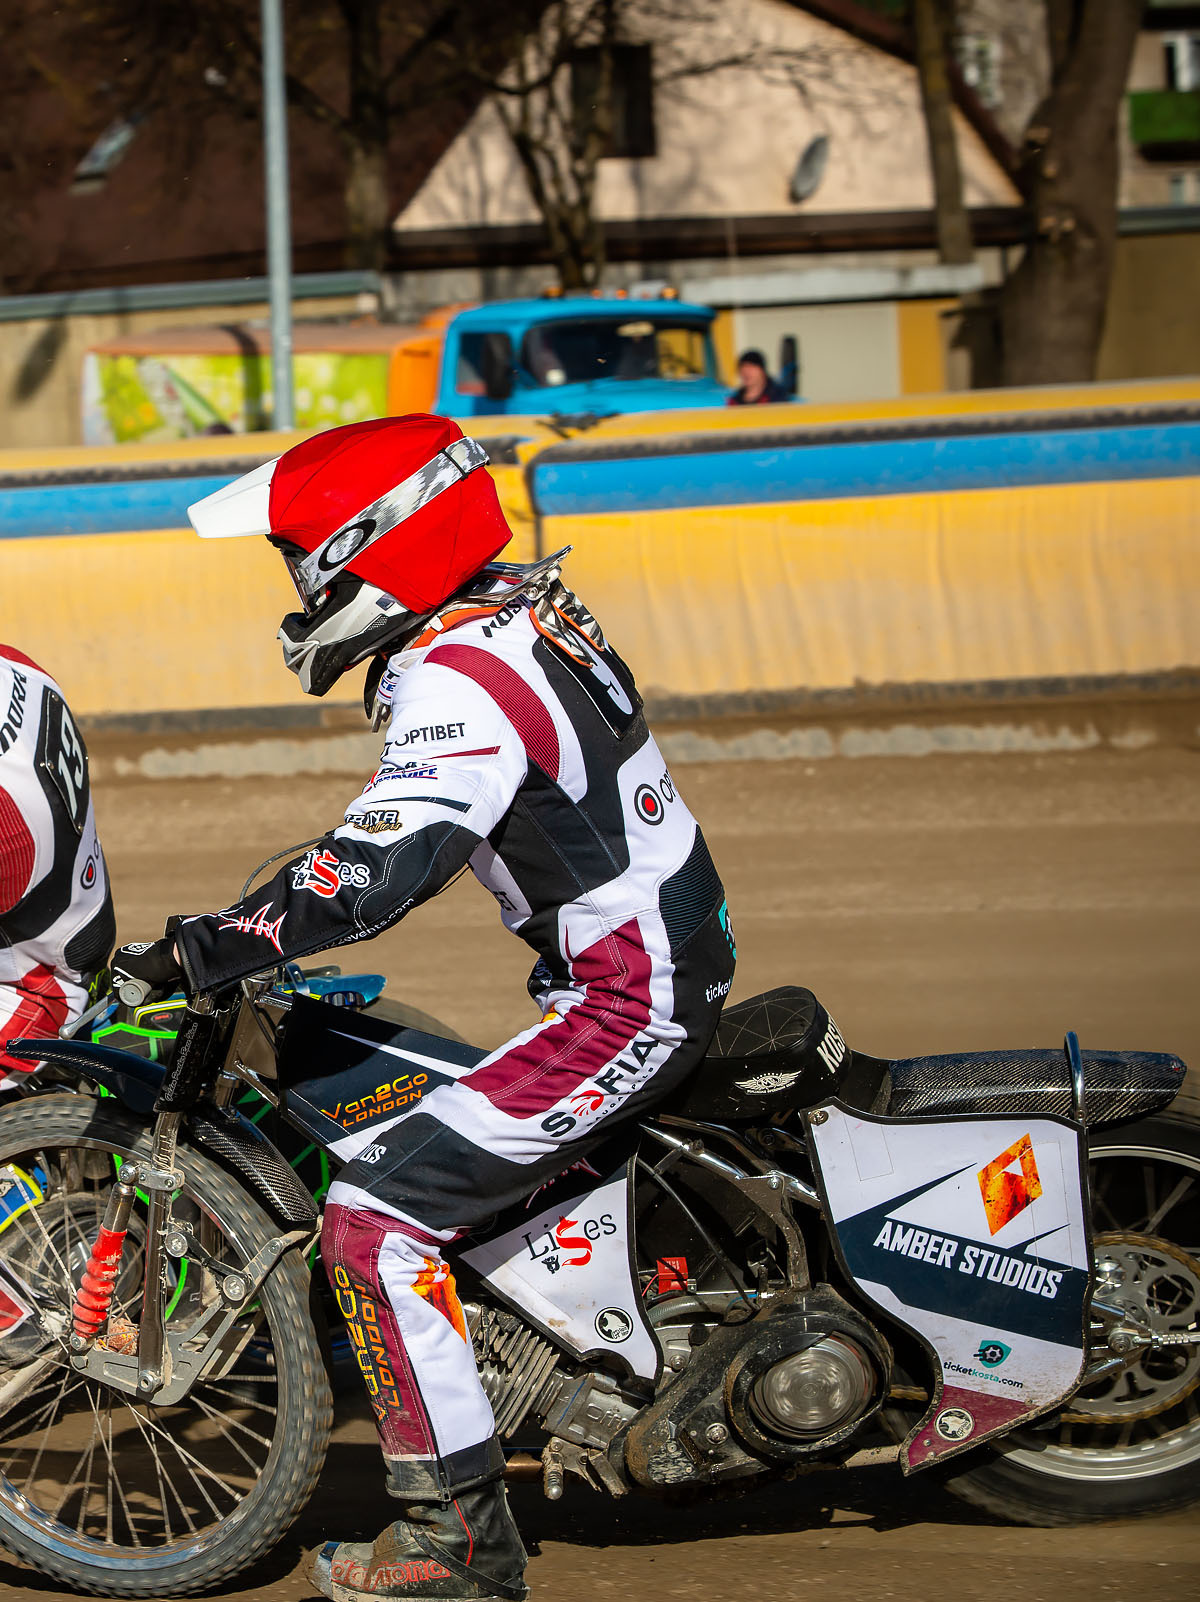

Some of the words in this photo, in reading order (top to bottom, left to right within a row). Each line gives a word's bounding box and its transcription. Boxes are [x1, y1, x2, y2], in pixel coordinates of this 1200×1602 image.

[58, 703, 84, 820] 13
[321, 1072, 428, 1119] Van2Go
[343, 1089, 423, 1127] LONDON
[873, 1220, 958, 1269] AMBER
[958, 1246, 1063, 1299] STUDIOS
[943, 1361, 1023, 1389] ticketkosta.com
